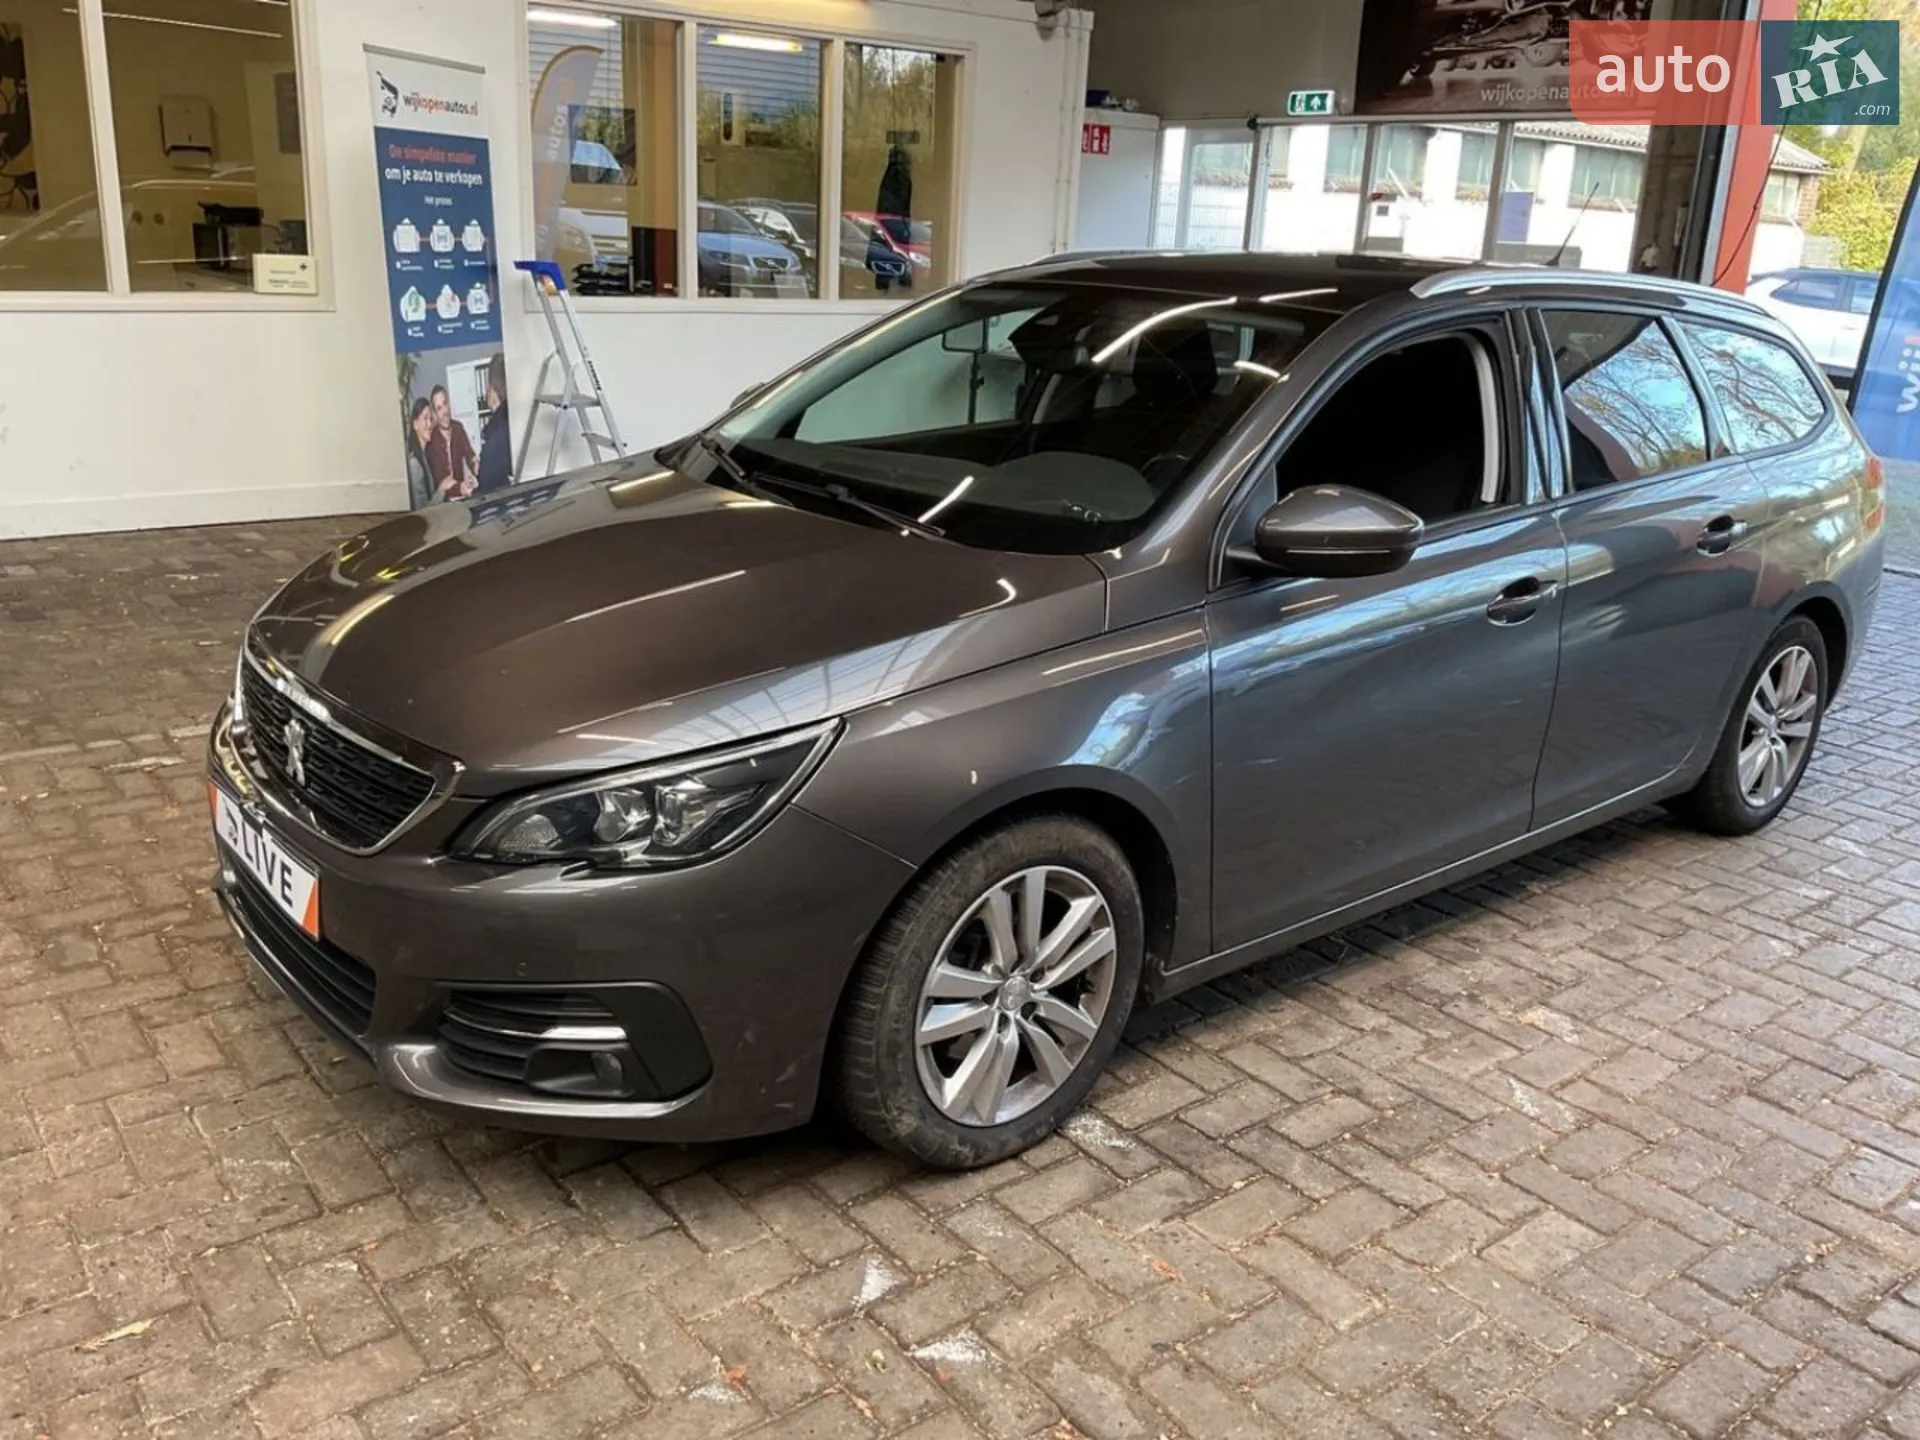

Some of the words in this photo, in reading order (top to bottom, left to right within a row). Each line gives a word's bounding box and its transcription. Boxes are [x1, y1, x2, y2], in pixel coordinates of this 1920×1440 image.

[403, 92, 478, 116] wijkopenautos.nl
[385, 167, 401, 180] om
[402, 164, 411, 186] je
[412, 169, 433, 182] auto
[434, 169, 444, 183] te
[445, 170, 482, 188] verkopen
[241, 818, 294, 909] LIVE
